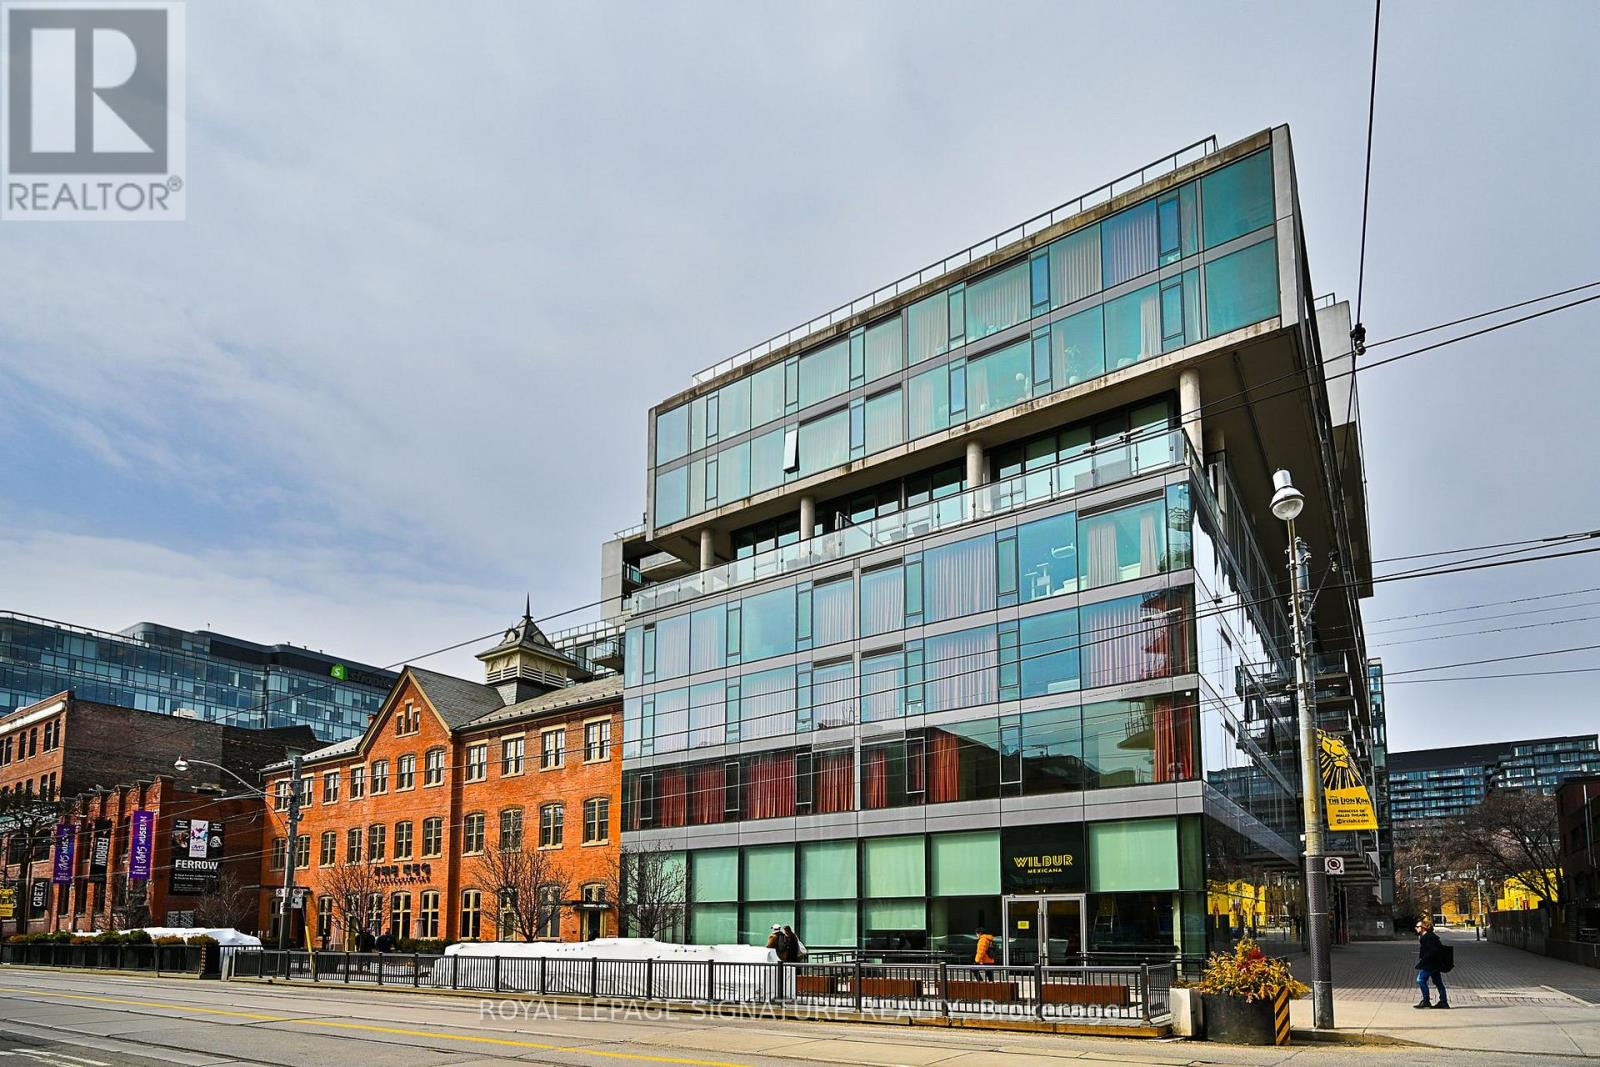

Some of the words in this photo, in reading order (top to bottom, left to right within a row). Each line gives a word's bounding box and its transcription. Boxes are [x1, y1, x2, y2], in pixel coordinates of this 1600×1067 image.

[95, 837, 109, 866] FERROW
[175, 859, 218, 870] FERROW
[1014, 855, 1073, 867] WILBUR
